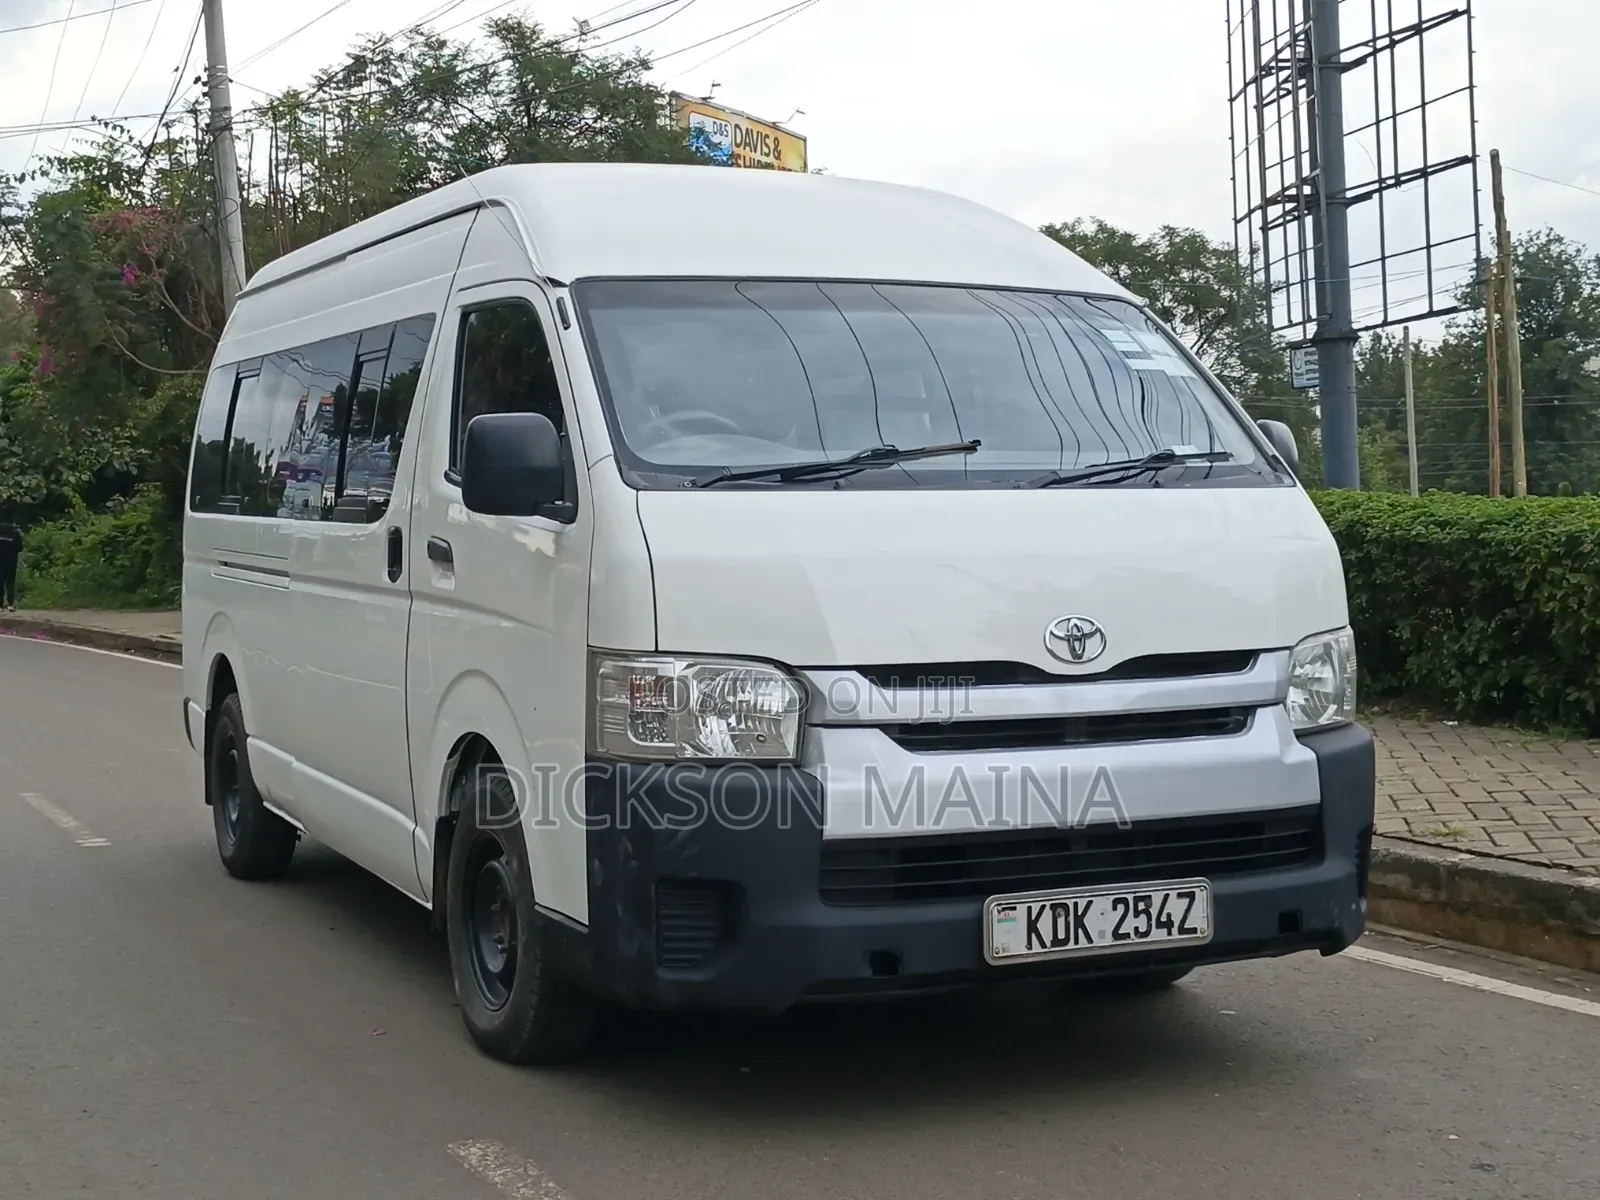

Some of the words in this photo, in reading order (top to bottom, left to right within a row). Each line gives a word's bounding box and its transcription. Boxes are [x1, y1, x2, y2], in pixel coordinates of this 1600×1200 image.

[712, 120, 729, 138] D&S
[734, 123, 771, 158] DAVIS
[772, 136, 782, 161] &
[1026, 899, 1094, 950] KDK
[1111, 891, 1198, 942] 254Z
